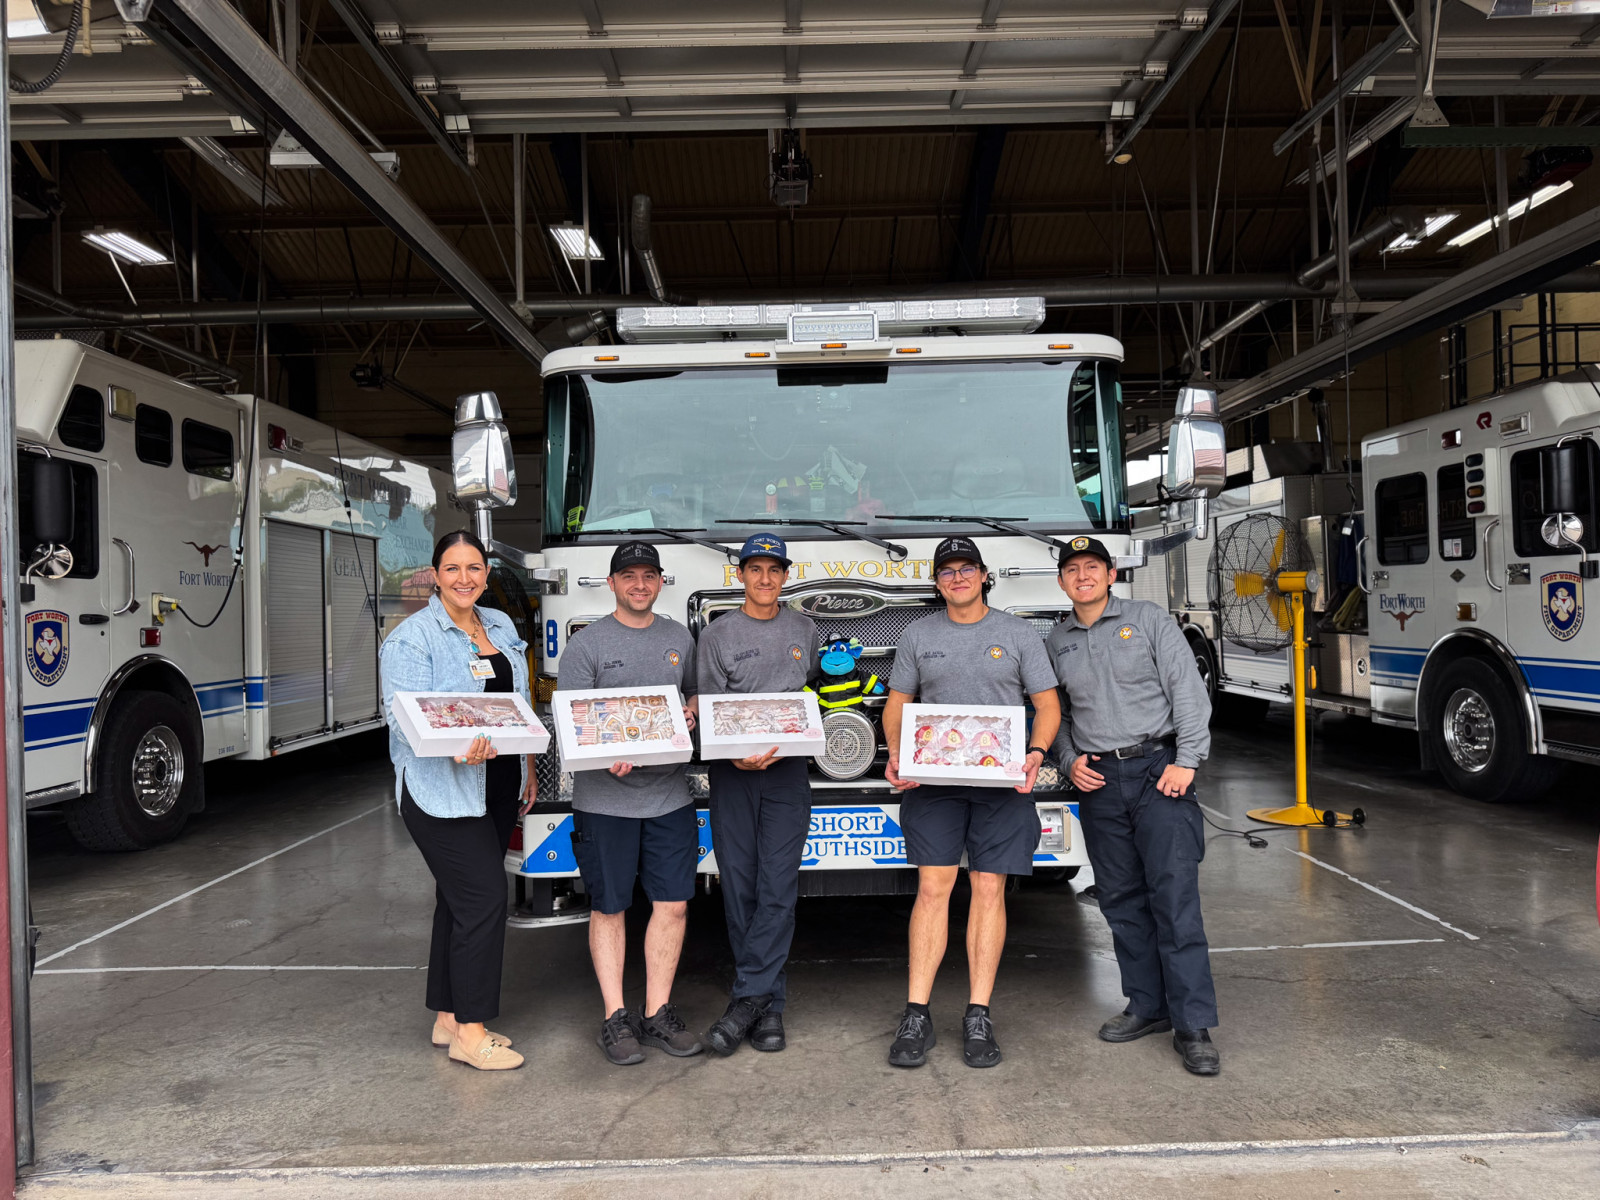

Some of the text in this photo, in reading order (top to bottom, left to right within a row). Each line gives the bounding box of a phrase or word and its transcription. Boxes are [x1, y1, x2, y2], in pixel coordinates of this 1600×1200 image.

[634, 548, 642, 557] 8
[951, 543, 959, 551] 8
[179, 570, 231, 587] FORT WORTH
[723, 561, 812, 588] FT
[1542, 573, 1581, 584] FORT WORTH
[811, 594, 865, 612] Pierce
[26, 612, 67, 624] FORT WORTH
[1543, 604, 1583, 638] FIRE DEPARTMENT
[545, 618, 559, 658] 8
[27, 645, 68, 683] FIRE DEPARTMENT
[808, 815, 883, 832] SHORT
[801, 840, 907, 857] OUTHSIDE
